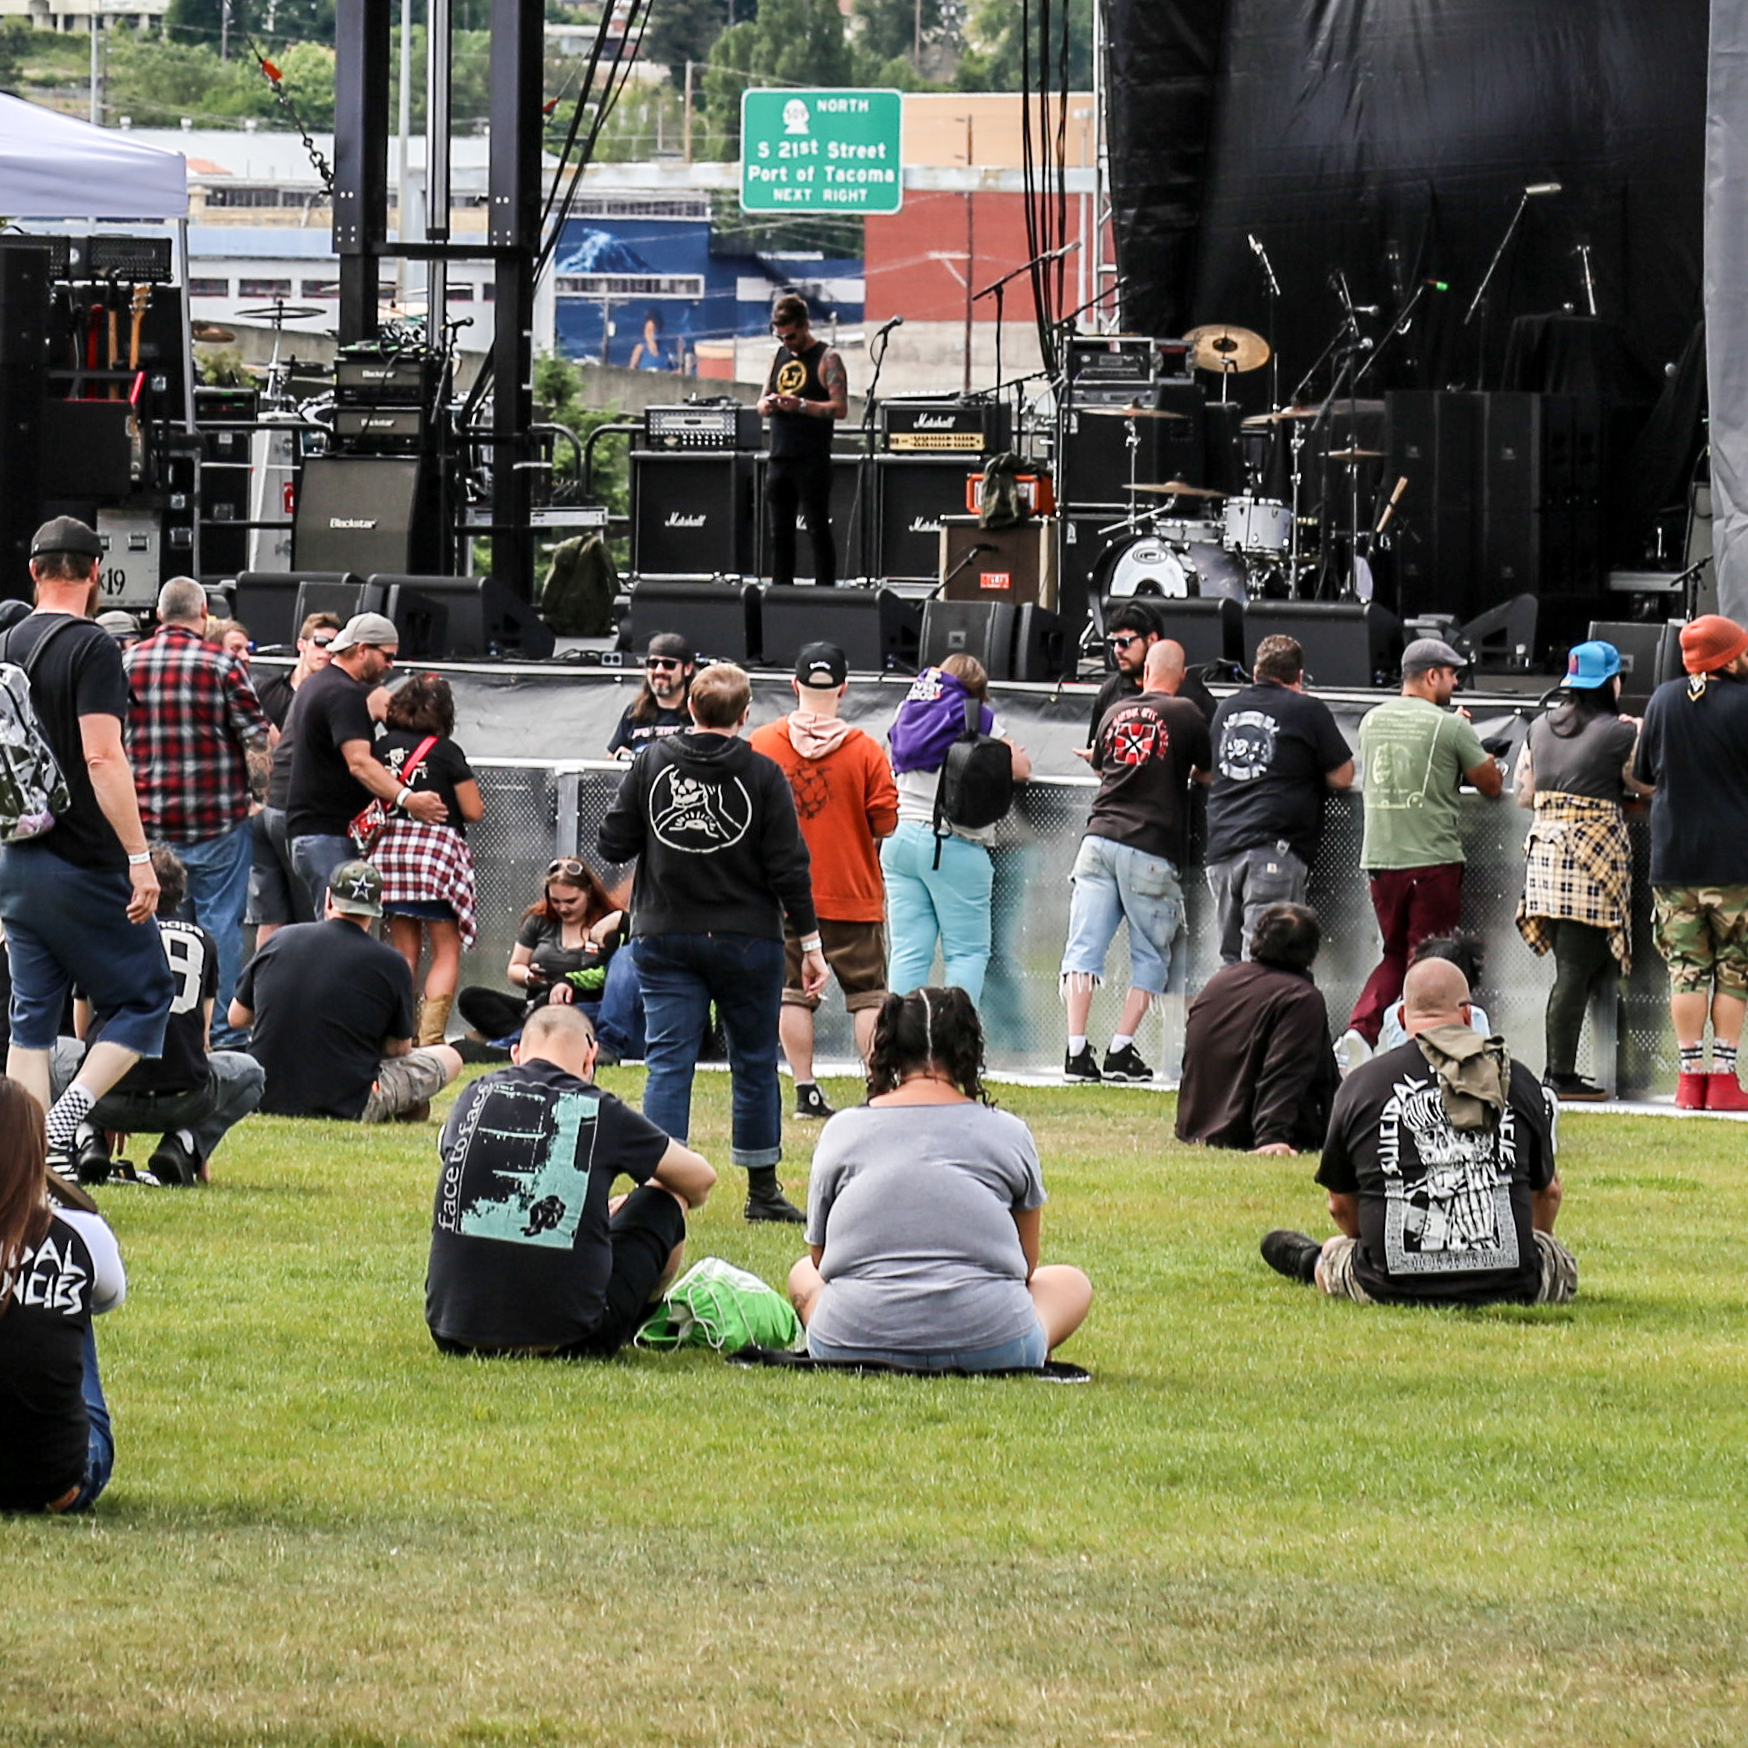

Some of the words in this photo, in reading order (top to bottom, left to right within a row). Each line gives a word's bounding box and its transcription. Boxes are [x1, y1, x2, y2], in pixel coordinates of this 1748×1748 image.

[817, 99, 869, 113] NORTH
[758, 141, 770, 159] S
[778, 139, 819, 159] 21st
[827, 141, 887, 159] Street
[748, 165, 788, 182] Port
[796, 166, 815, 182] of
[824, 166, 895, 183] Tacoma
[773, 189, 813, 202] NEXT
[822, 189, 868, 202] RIGHT
[438, 1166, 460, 1233] face
[450, 1136, 468, 1164] to
